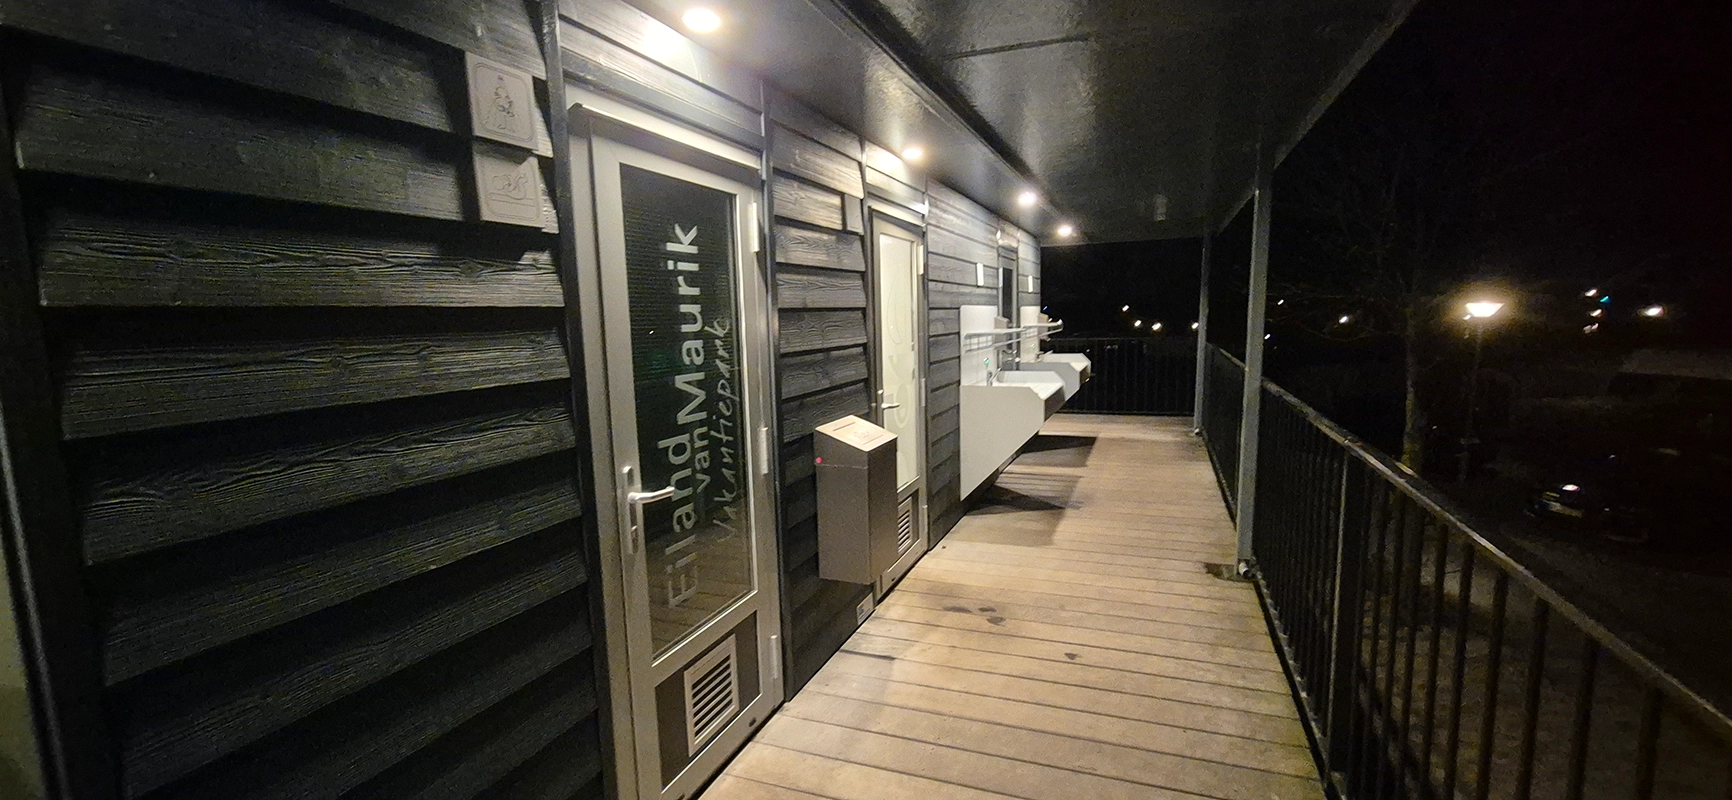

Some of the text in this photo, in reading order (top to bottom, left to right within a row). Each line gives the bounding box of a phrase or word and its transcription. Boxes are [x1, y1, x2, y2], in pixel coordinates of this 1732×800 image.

[658, 224, 711, 607] Eiland van Maurik
[704, 318, 739, 542] Vakantiepark
